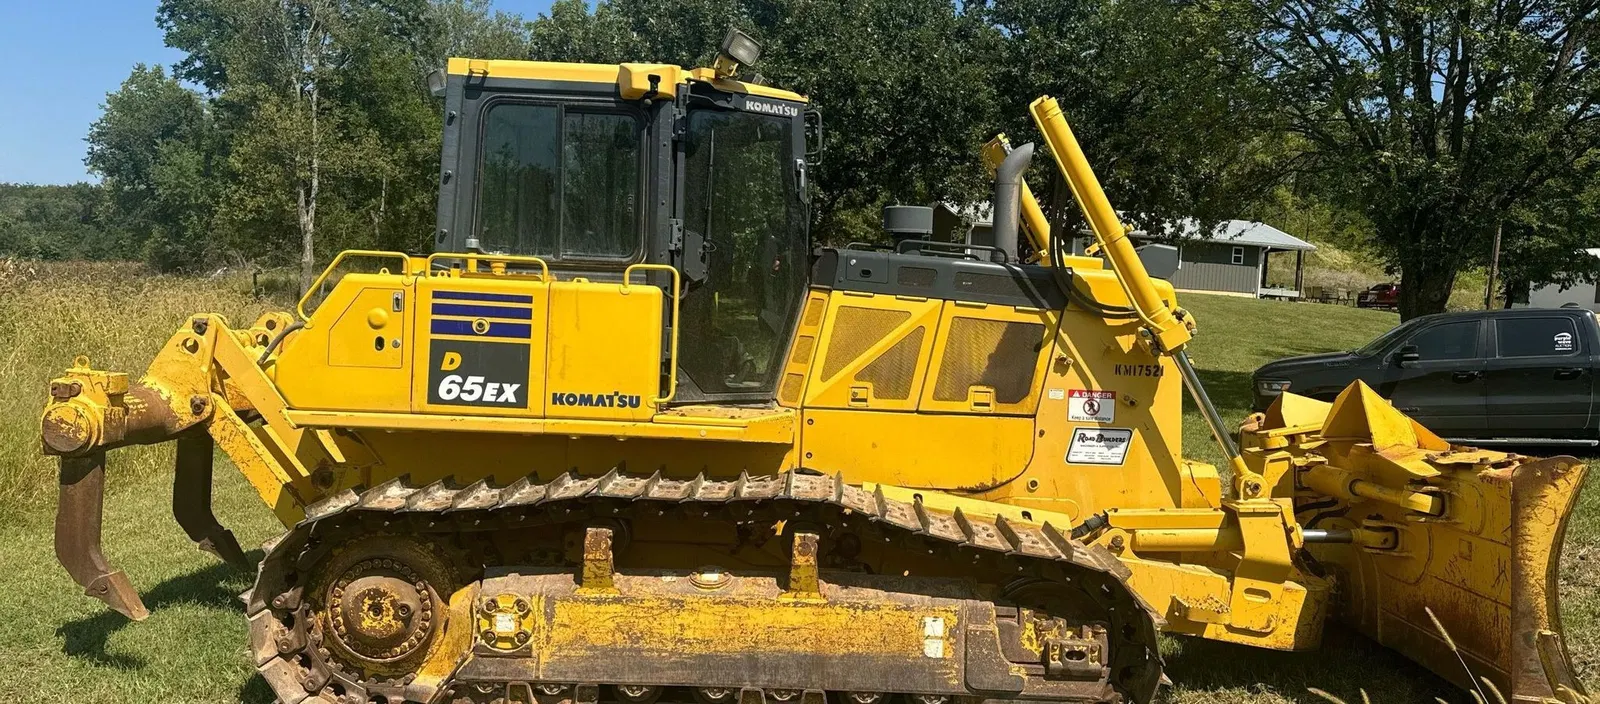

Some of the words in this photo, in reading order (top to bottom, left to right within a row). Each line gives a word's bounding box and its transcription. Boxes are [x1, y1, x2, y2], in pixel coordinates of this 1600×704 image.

[745, 101, 798, 116] KOMATSU
[440, 352, 462, 371] D
[438, 374, 521, 403] 65EX
[1082, 391, 1112, 399] DANGER
[552, 391, 640, 408] KOMATSU
